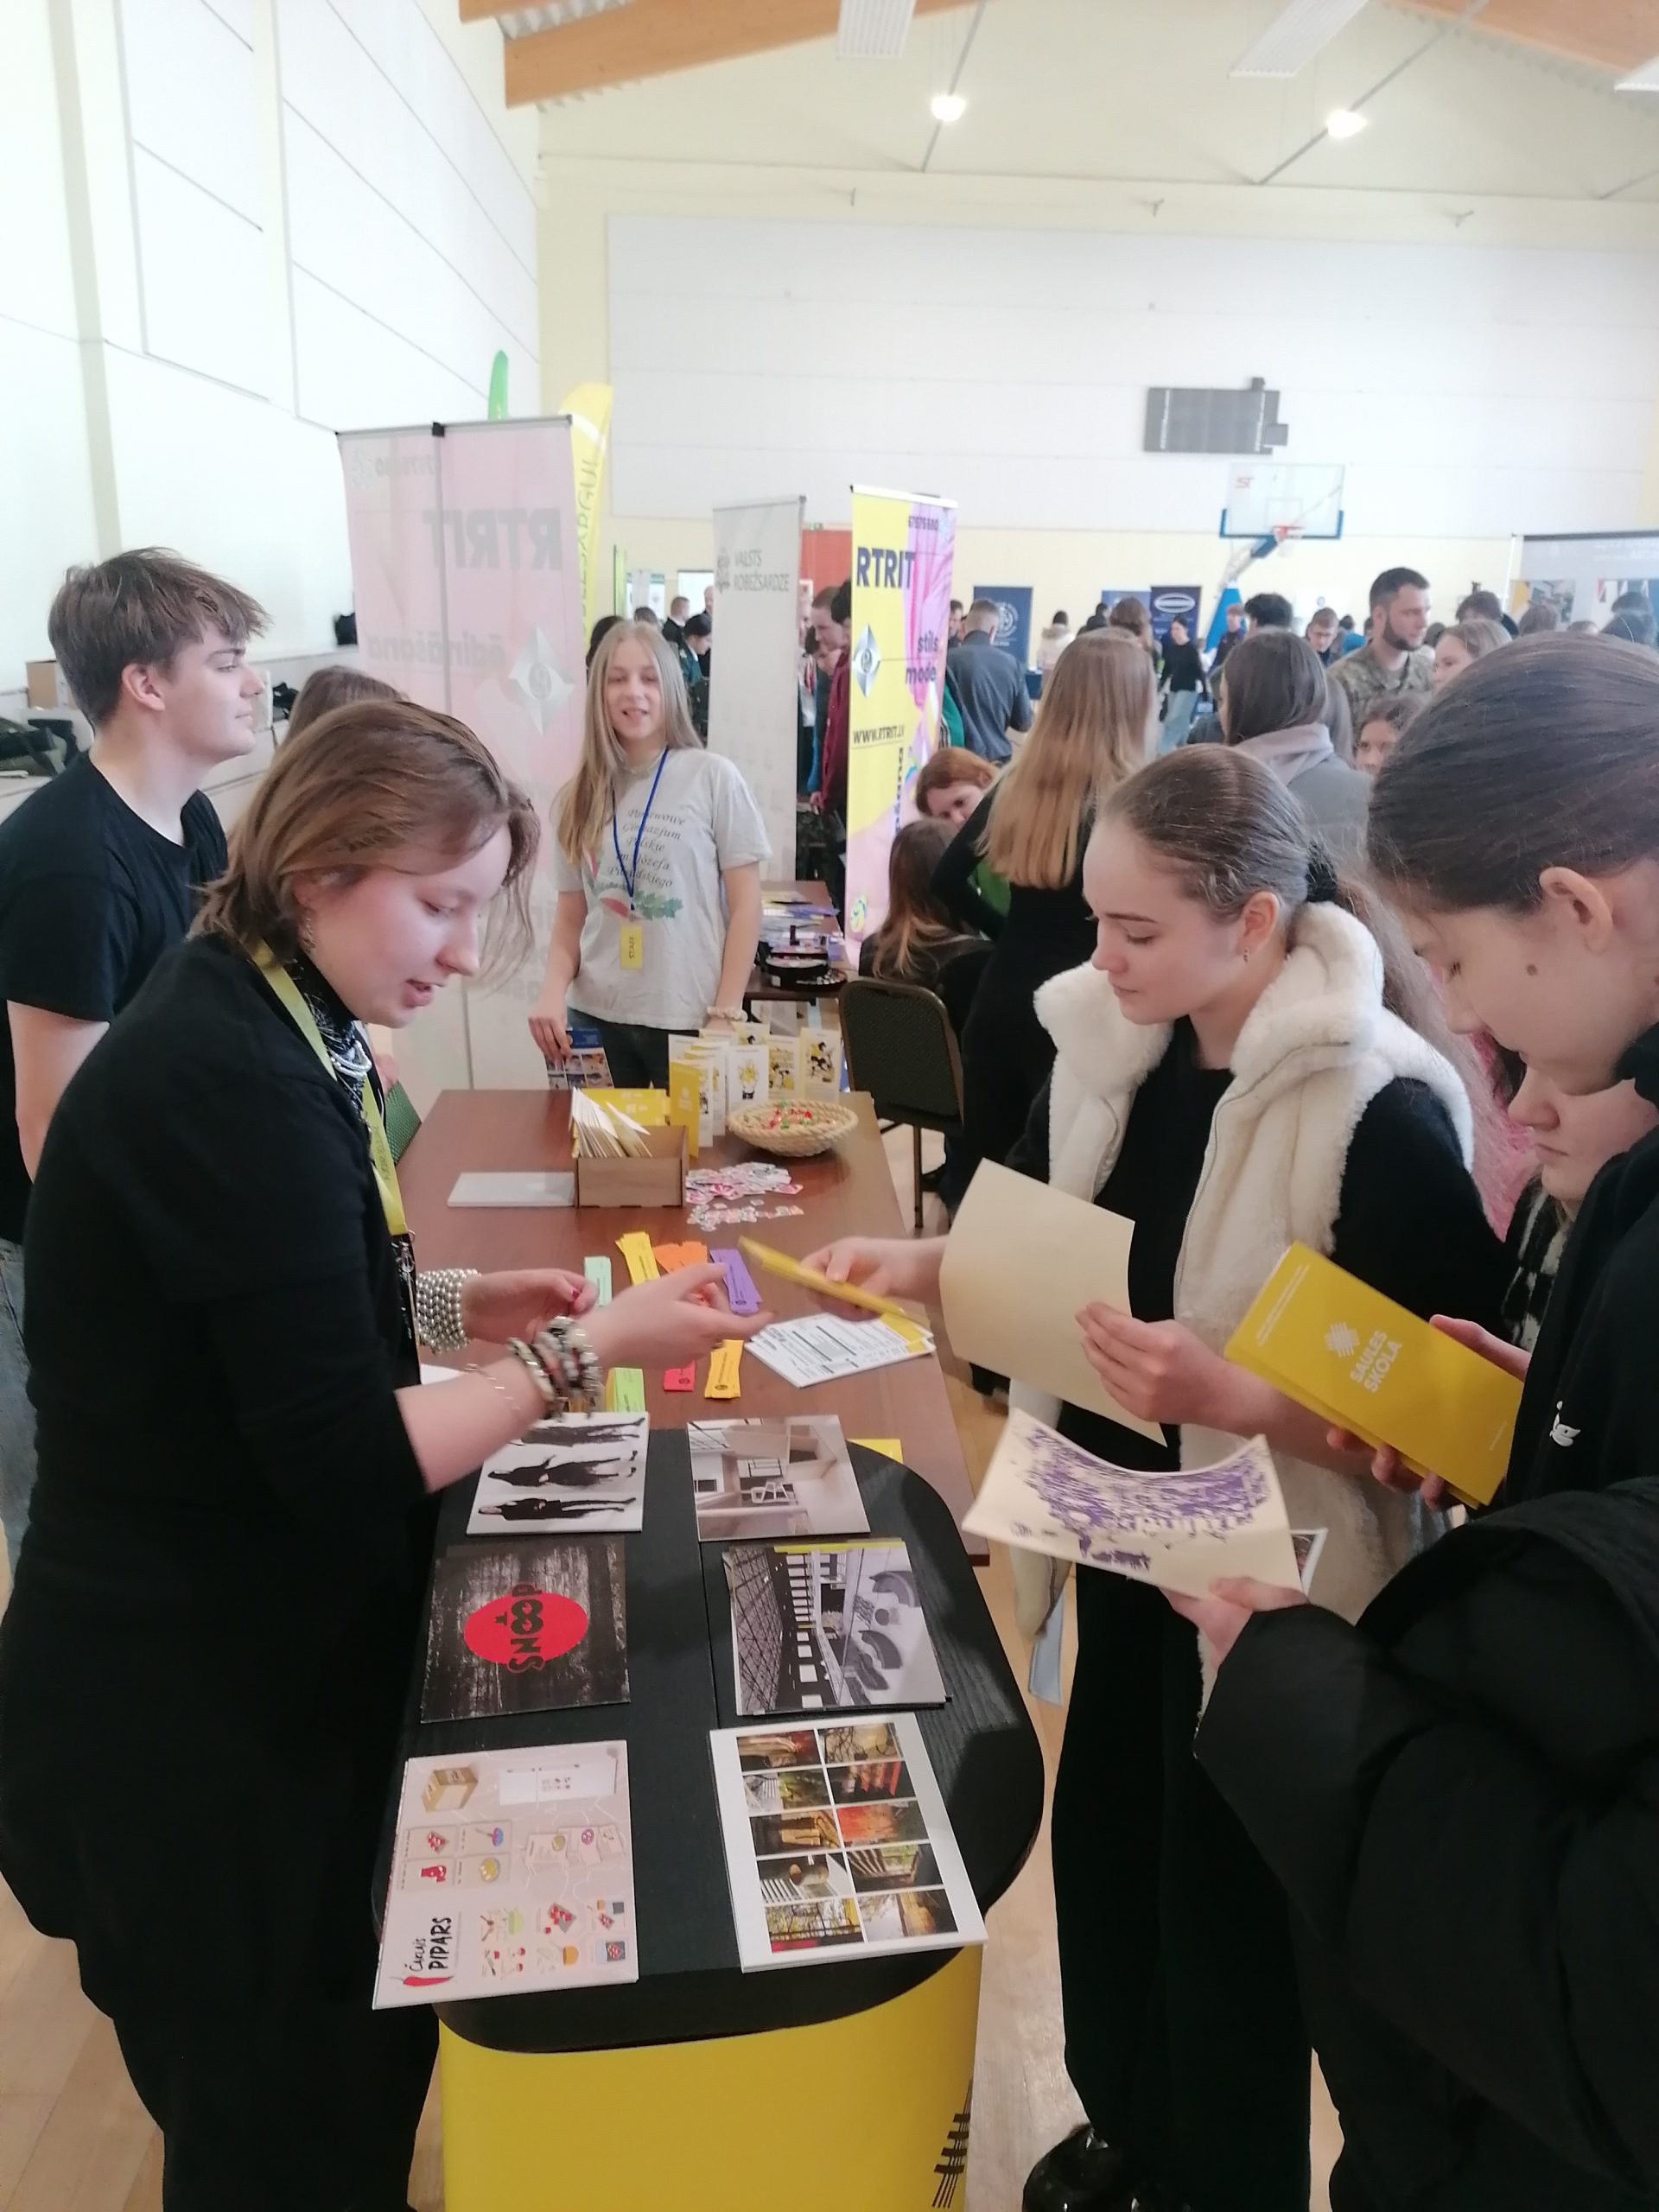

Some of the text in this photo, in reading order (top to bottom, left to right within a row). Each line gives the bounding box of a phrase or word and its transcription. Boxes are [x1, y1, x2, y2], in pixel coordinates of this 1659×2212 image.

[734, 550, 762, 568] VALSTS
[856, 546, 916, 589] RTRIT
[918, 631, 939, 653] stils
[906, 663, 937, 684] mode
[1350, 1329, 1388, 1384] SAULES
[1363, 1339, 1403, 1394] SKOLA
[428, 1916, 453, 1970] PIPARS
